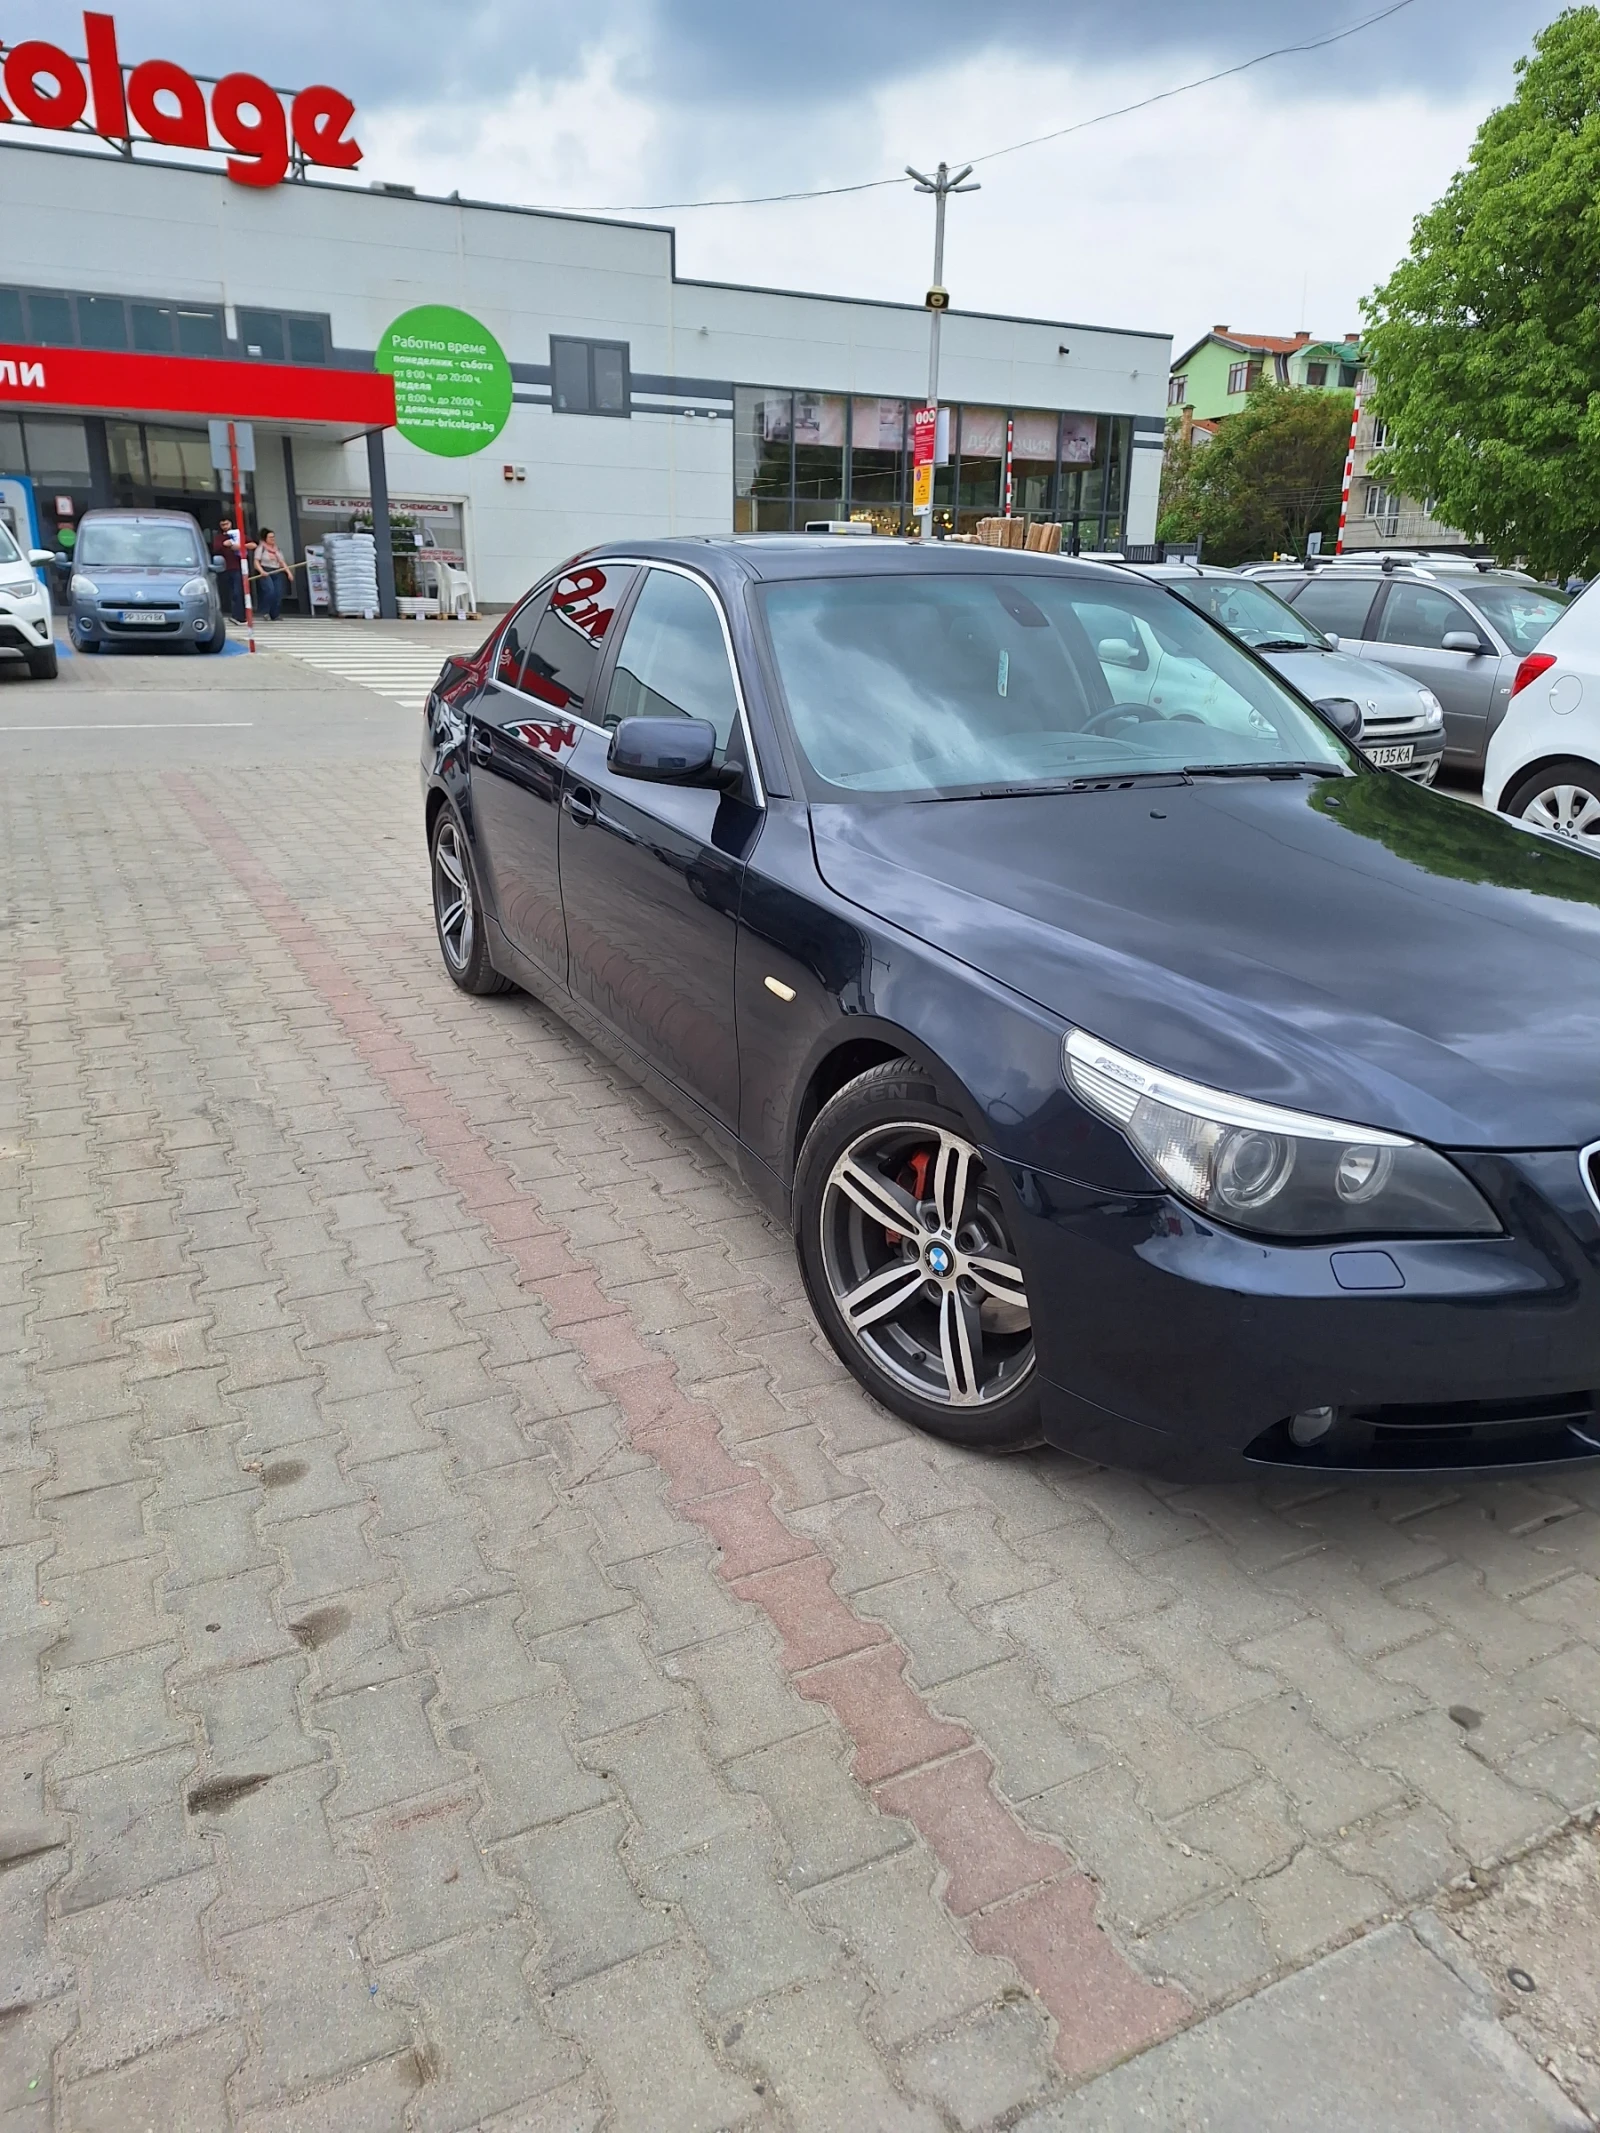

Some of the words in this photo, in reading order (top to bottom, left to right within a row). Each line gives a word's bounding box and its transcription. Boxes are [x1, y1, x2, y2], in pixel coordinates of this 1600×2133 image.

[0, 11, 364, 187] olage
[392, 335, 446, 351] Работно
[447, 342, 487, 354] време
[393, 355, 453, 368] понеделник
[460, 359, 494, 371] събота
[436, 373, 448, 381] до
[395, 381, 432, 391] неделя
[396, 393, 406, 401] от
[437, 397, 449, 405] до
[405, 405, 460, 417] денонощно
[462, 409, 474, 417] на
[397, 417, 495, 433] www.mr-bricolage.bg
[967, 434, 1051, 453] ДЕКОАЦИЯ
[307, 498, 338, 507] DIESEL
[400, 503, 448, 512] CHEMICALS
[1373, 748, 1396, 763] 3135
